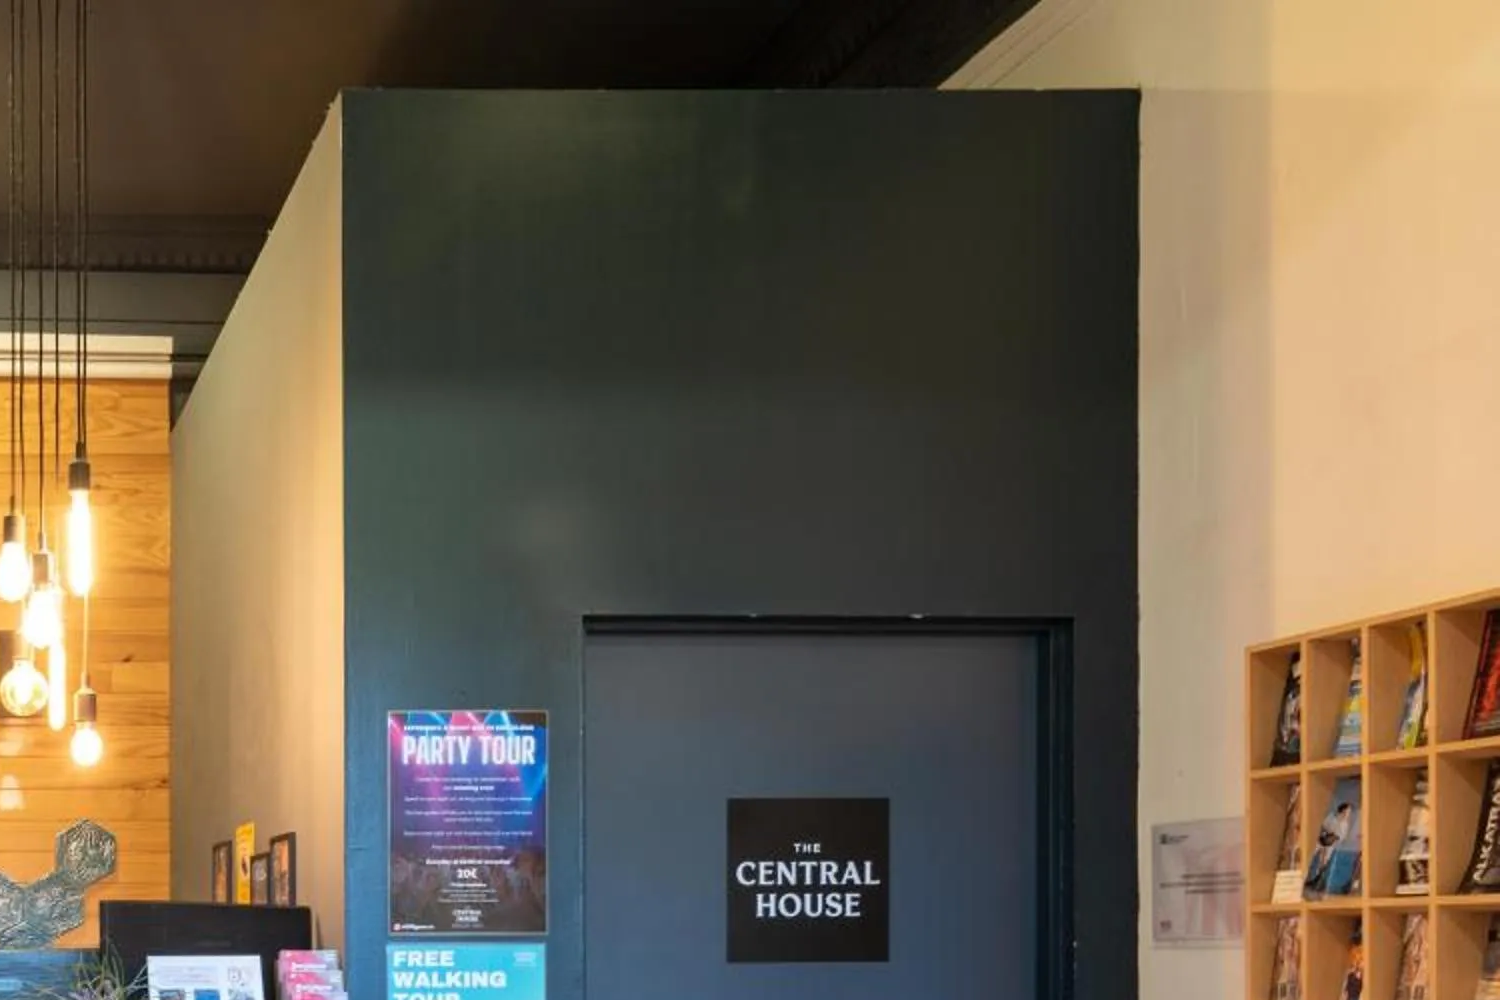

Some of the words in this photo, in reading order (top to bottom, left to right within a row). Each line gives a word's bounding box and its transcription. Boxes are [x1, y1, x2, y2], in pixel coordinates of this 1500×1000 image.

[403, 735, 471, 765] PARTY
[478, 735, 536, 765] TOUR
[793, 842, 821, 854] THE
[735, 860, 881, 886] CENTRAL
[755, 893, 861, 918] HOUSE
[393, 949, 455, 967] FREE
[392, 970, 507, 989] WALKING
